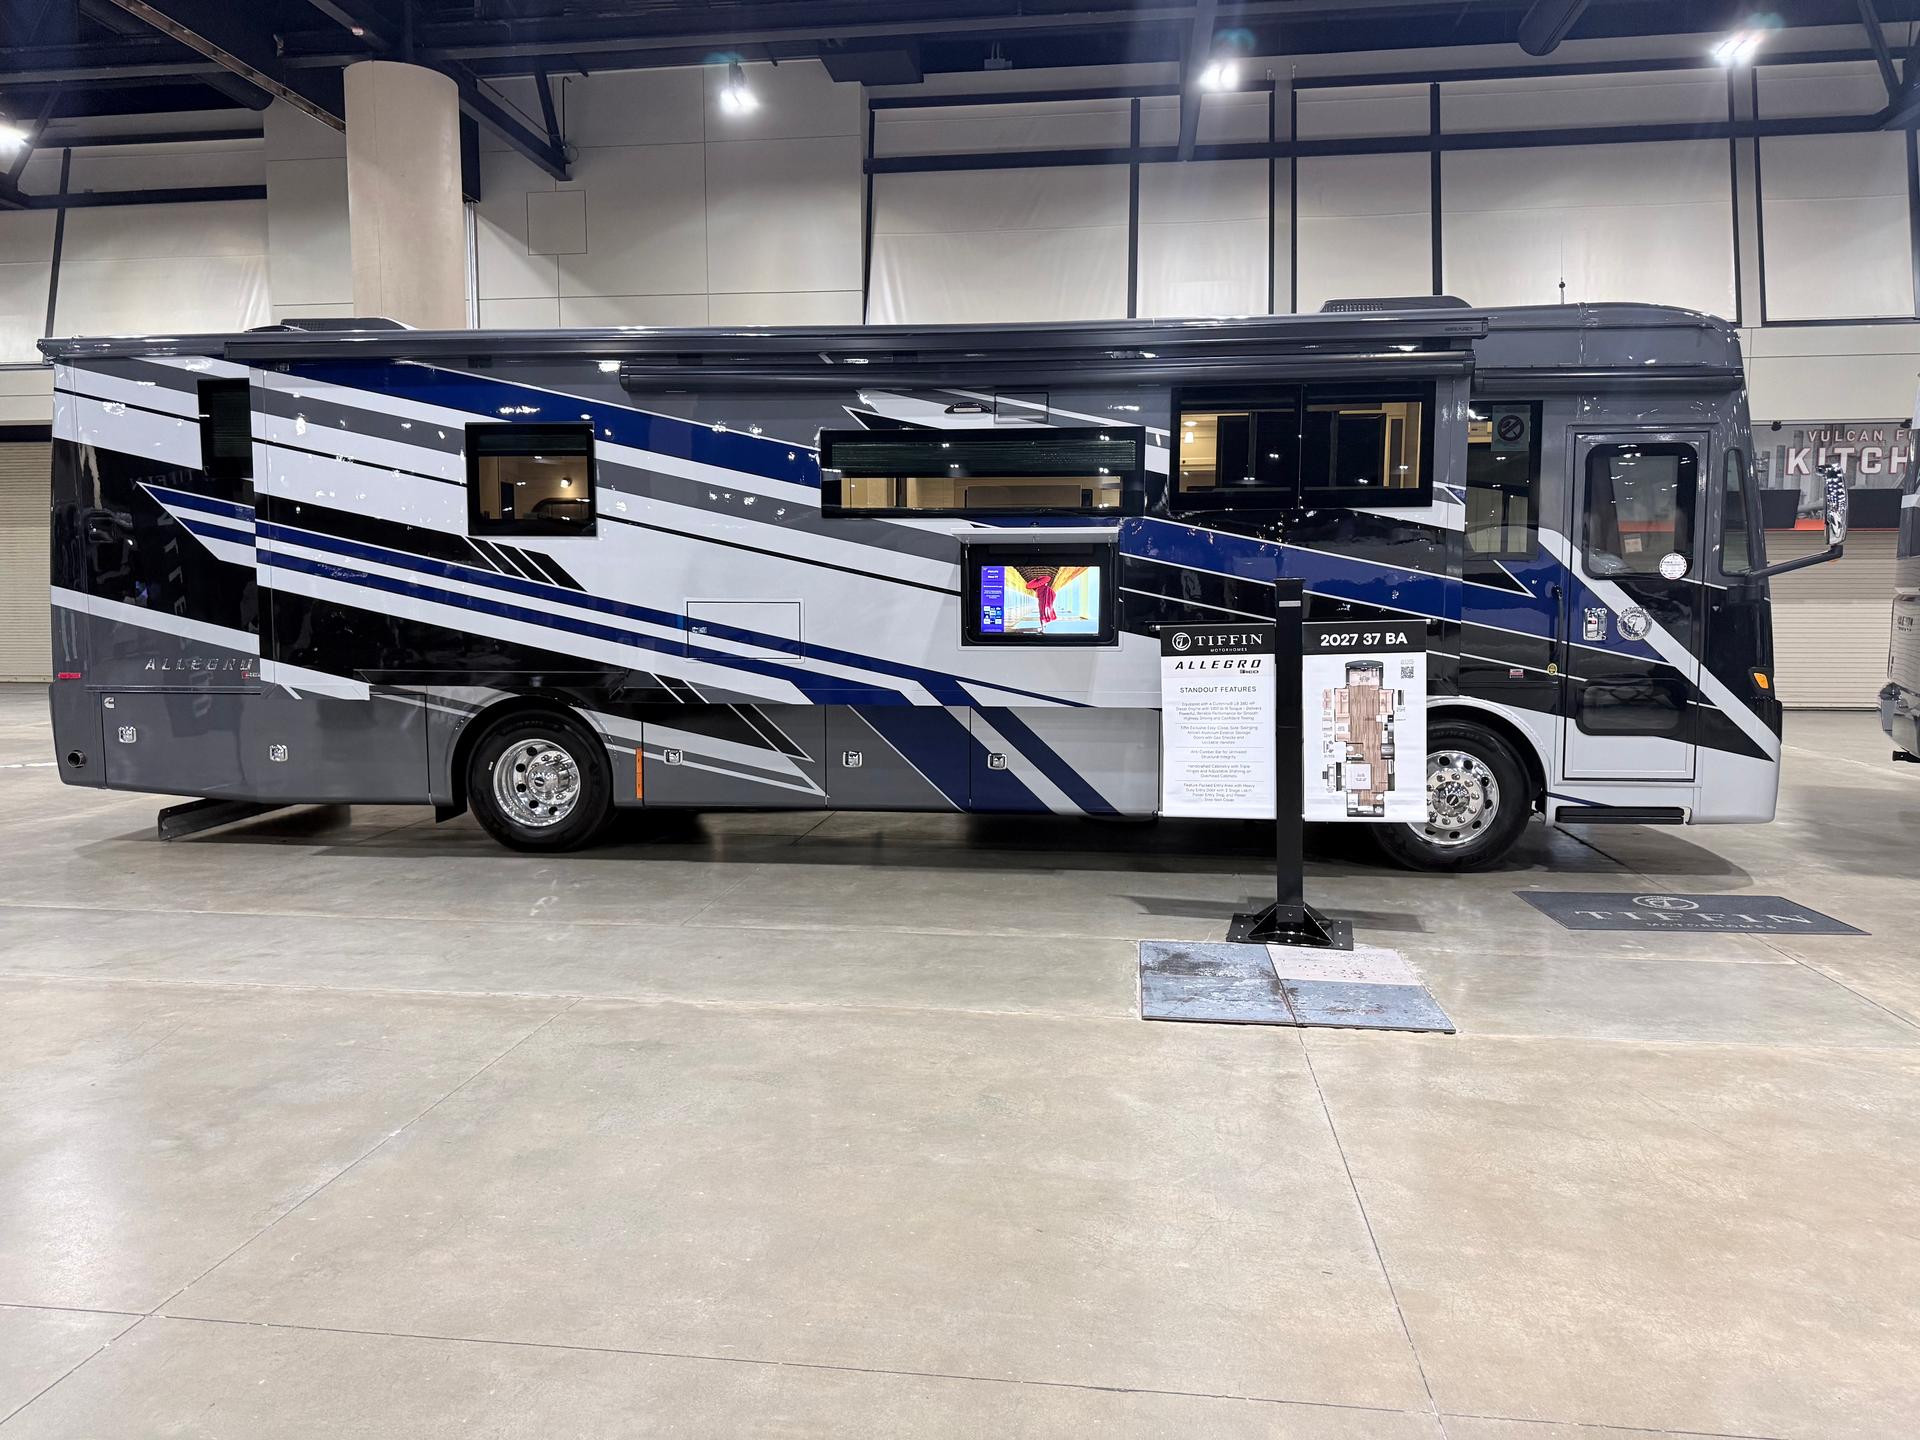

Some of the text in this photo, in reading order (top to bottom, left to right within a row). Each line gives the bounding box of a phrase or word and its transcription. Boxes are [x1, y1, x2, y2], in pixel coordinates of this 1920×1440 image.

[1808, 430, 1883, 442] VULCAN
[1195, 633, 1263, 646] TIFFIN
[1320, 632, 1408, 647] 2027 37 BA
[1175, 659, 1262, 670] ALLEGRO
[1220, 685, 1257, 693] FEATURES
[1575, 910, 1814, 924] TIFFIN
